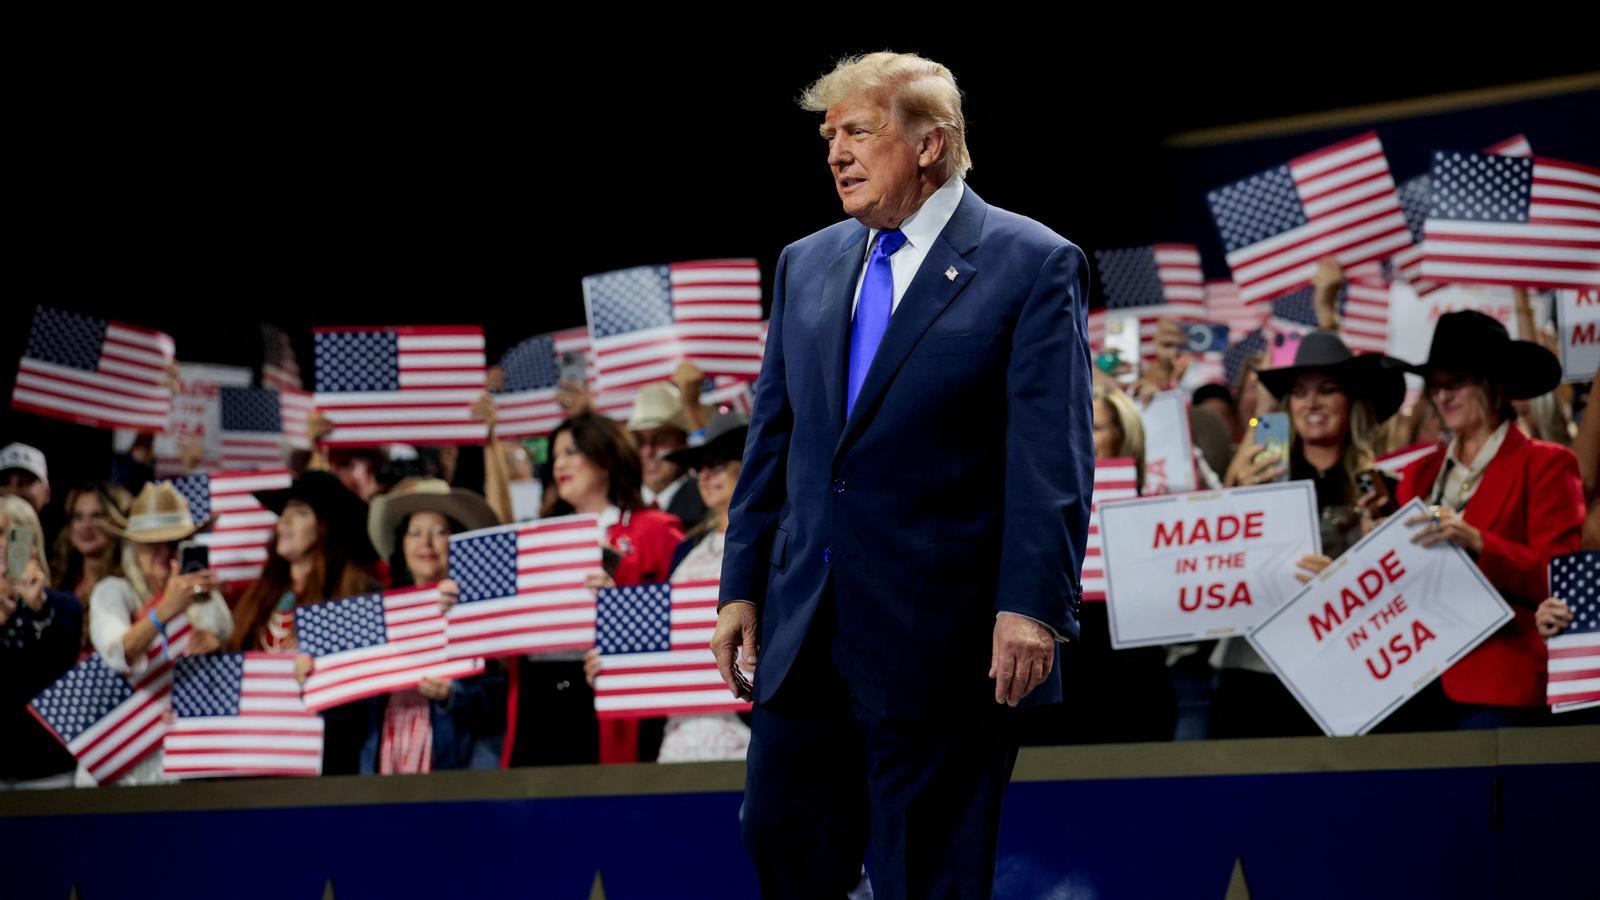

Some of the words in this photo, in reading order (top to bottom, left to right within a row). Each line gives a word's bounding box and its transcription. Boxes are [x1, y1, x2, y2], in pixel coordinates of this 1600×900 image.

[1151, 511, 1265, 549] MADE
[1175, 558, 1198, 574] IN
[1205, 552, 1245, 571] THE
[1177, 580, 1254, 613] USA
[1307, 549, 1407, 641] MADE
[1347, 629, 1369, 650] IN
[1369, 596, 1408, 632] THE
[1364, 619, 1437, 681] USA
